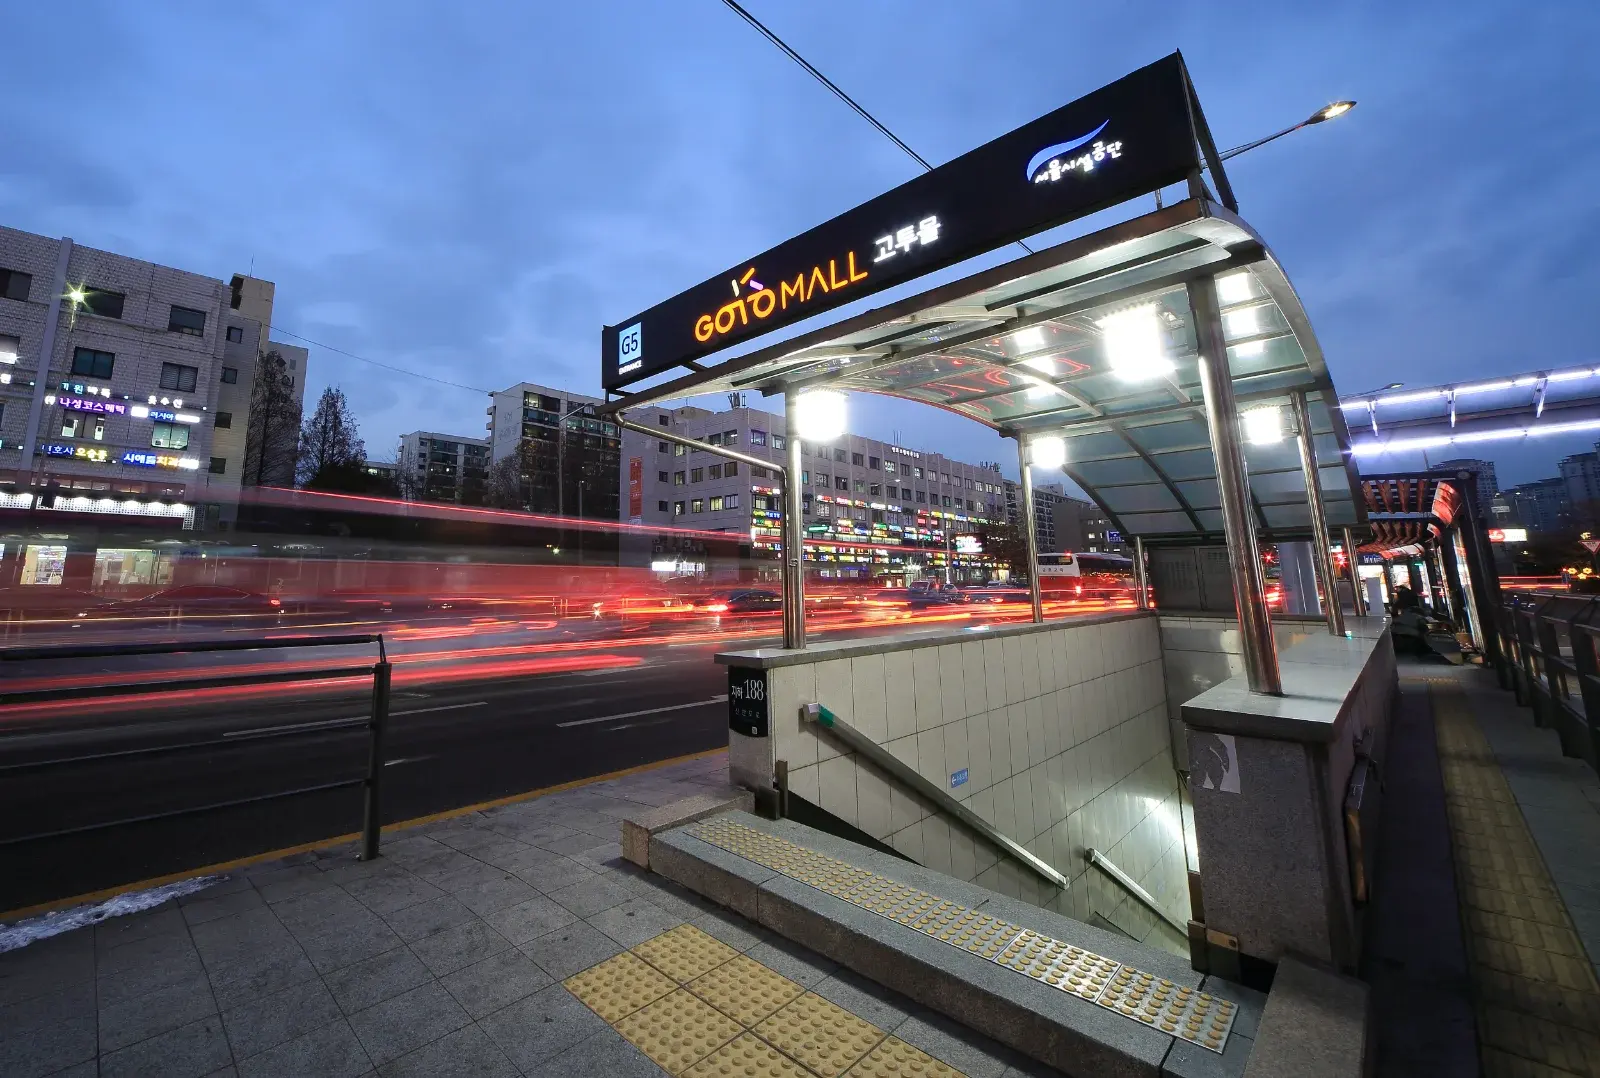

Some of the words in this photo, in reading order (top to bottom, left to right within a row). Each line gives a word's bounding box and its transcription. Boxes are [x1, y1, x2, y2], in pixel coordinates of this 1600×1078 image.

[873, 214, 942, 263] 고투몰
[694, 287, 776, 342] GOTO
[780, 251, 868, 311] MALL
[620, 331, 639, 356] G5
[744, 679, 764, 701] 188
